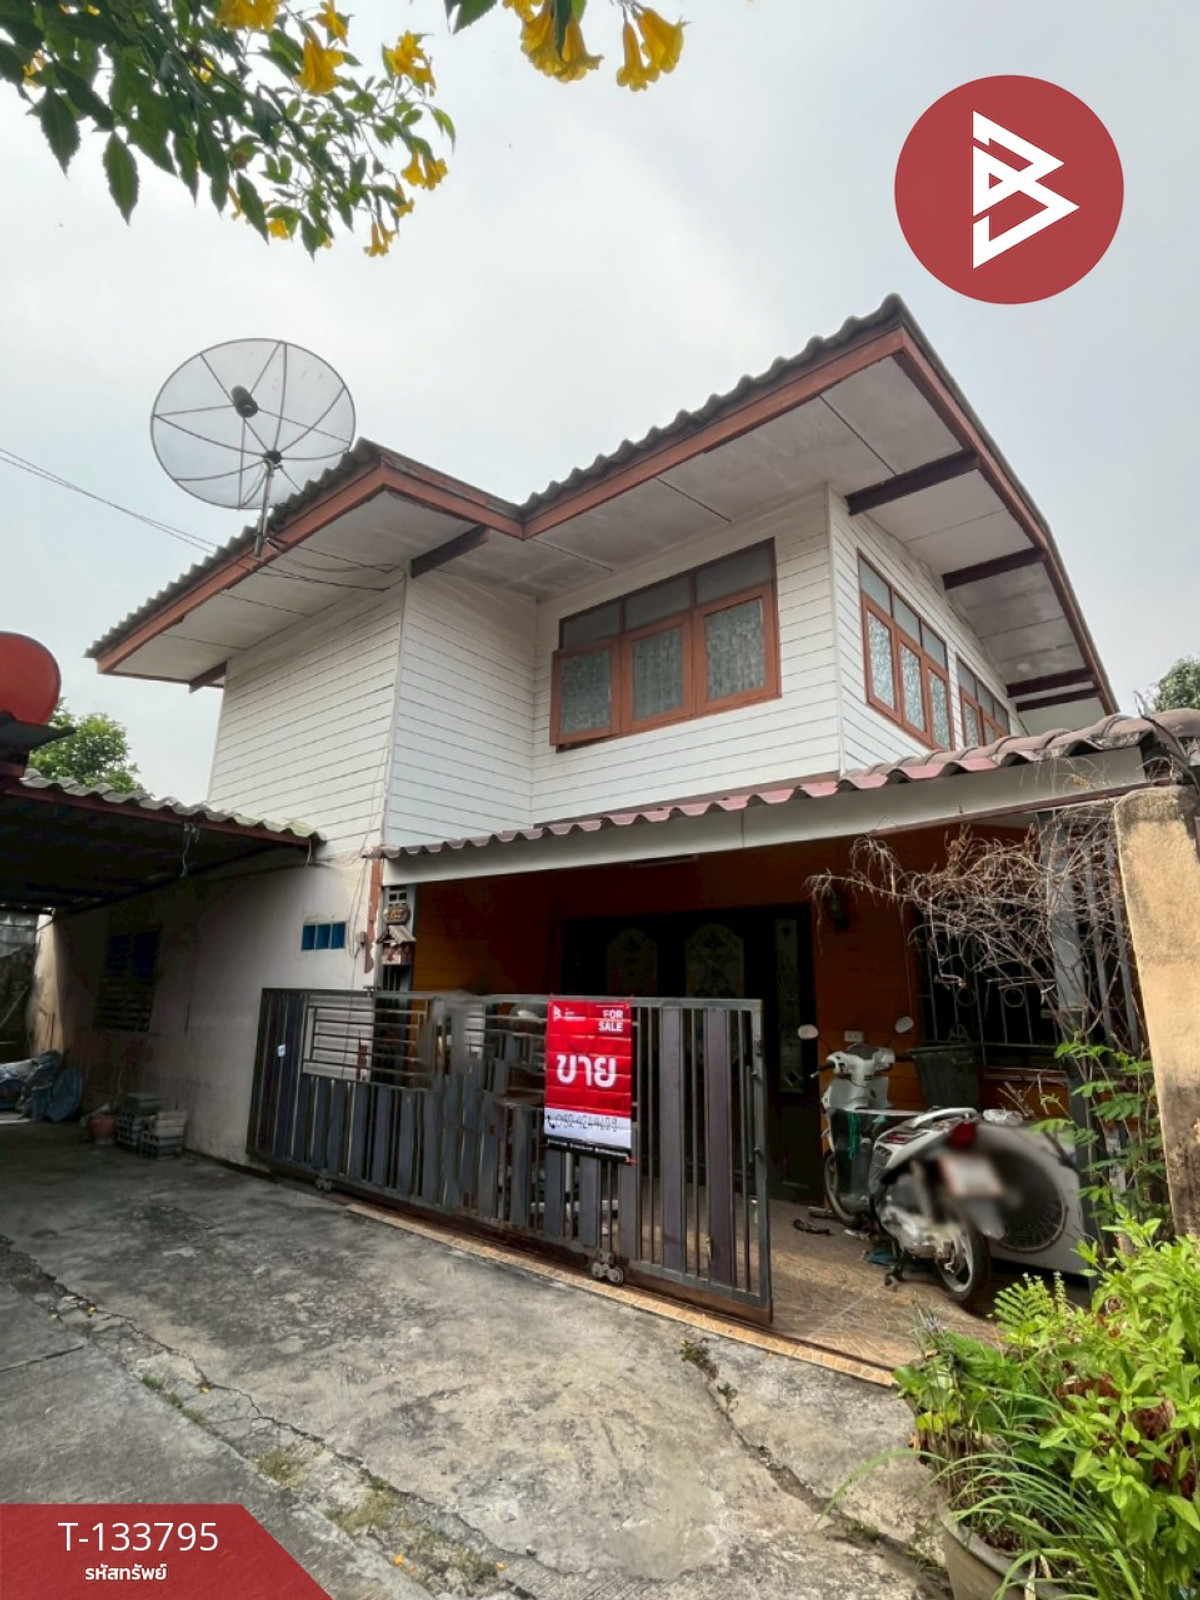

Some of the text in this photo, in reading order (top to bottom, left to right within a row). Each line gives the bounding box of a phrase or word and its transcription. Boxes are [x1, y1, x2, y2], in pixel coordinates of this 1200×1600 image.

[602, 1009, 624, 1020] FOR
[598, 1021, 624, 1032] SALE
[556, 1053, 617, 1088] ขาย
